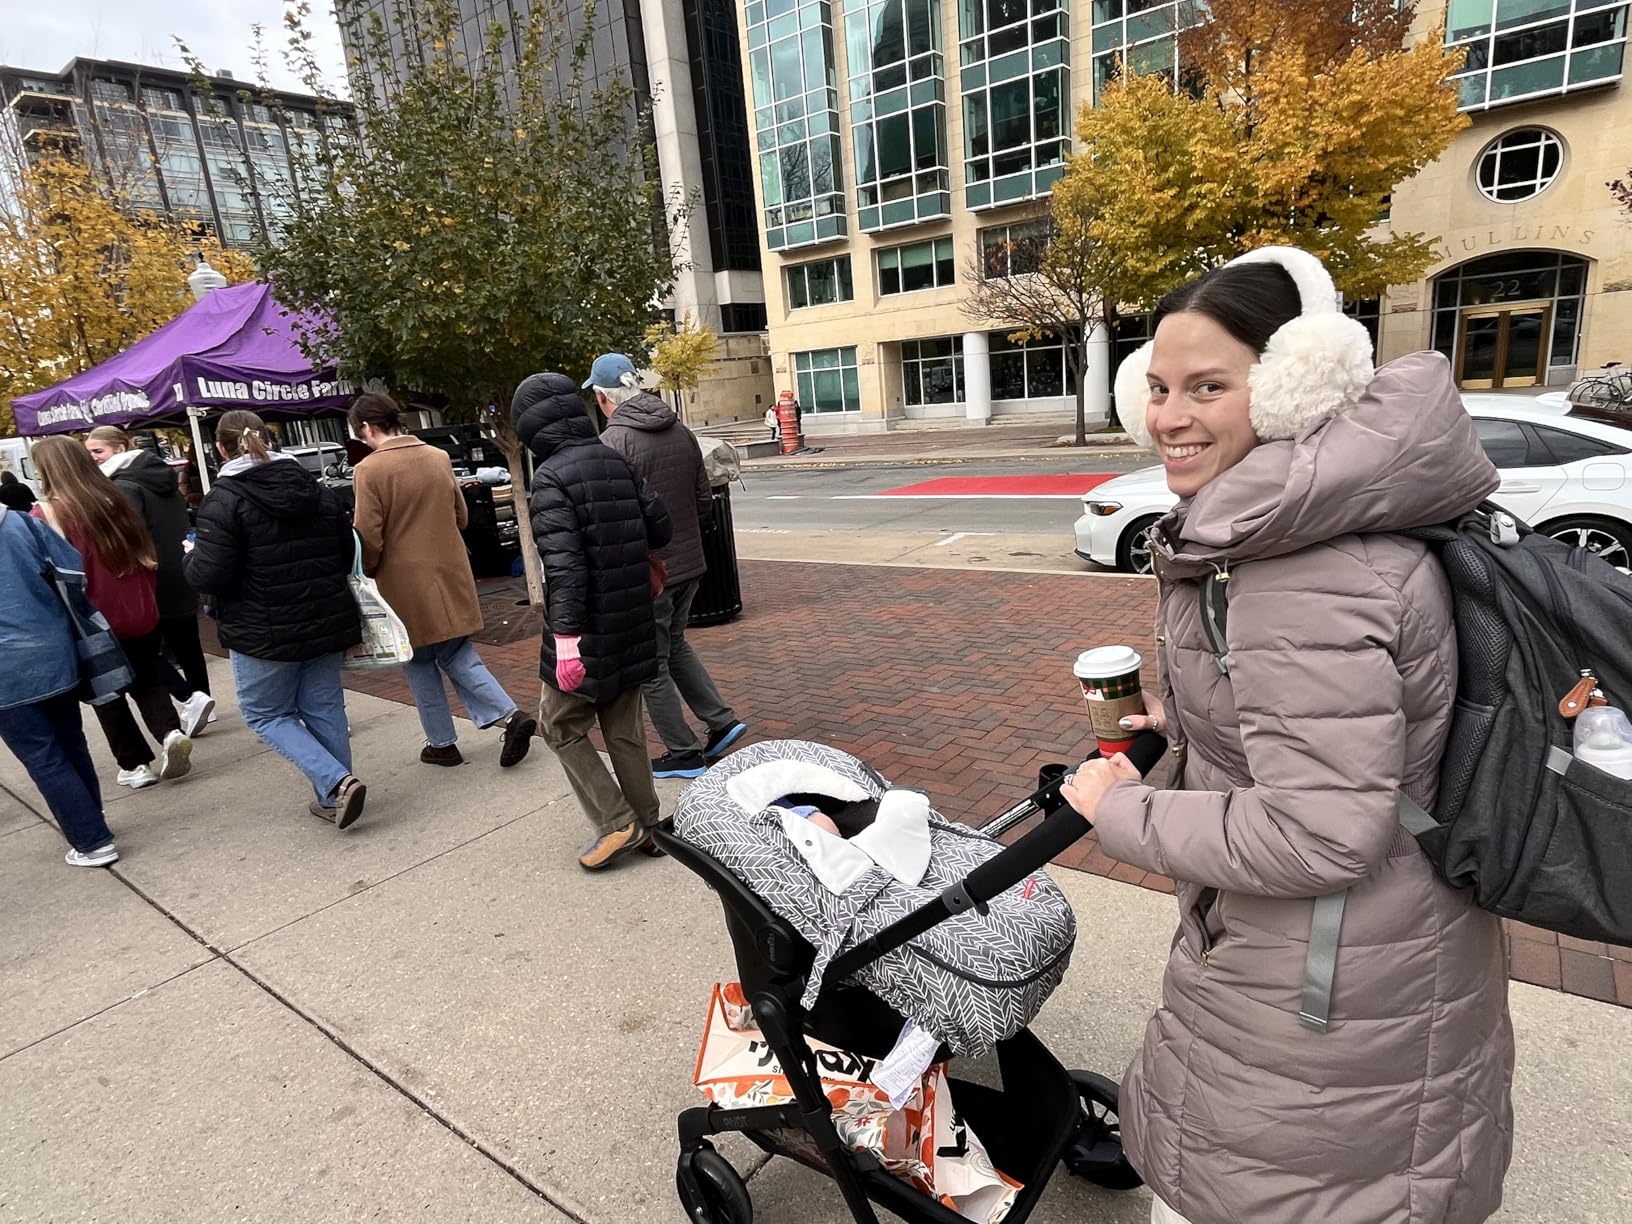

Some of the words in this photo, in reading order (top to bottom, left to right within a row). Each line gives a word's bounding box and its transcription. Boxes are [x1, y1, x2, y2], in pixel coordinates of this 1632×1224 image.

[1493, 279, 1520, 297] 22
[197, 376, 249, 400] Luna
[252, 380, 310, 401] Circle
[311, 379, 356, 398] Farm
